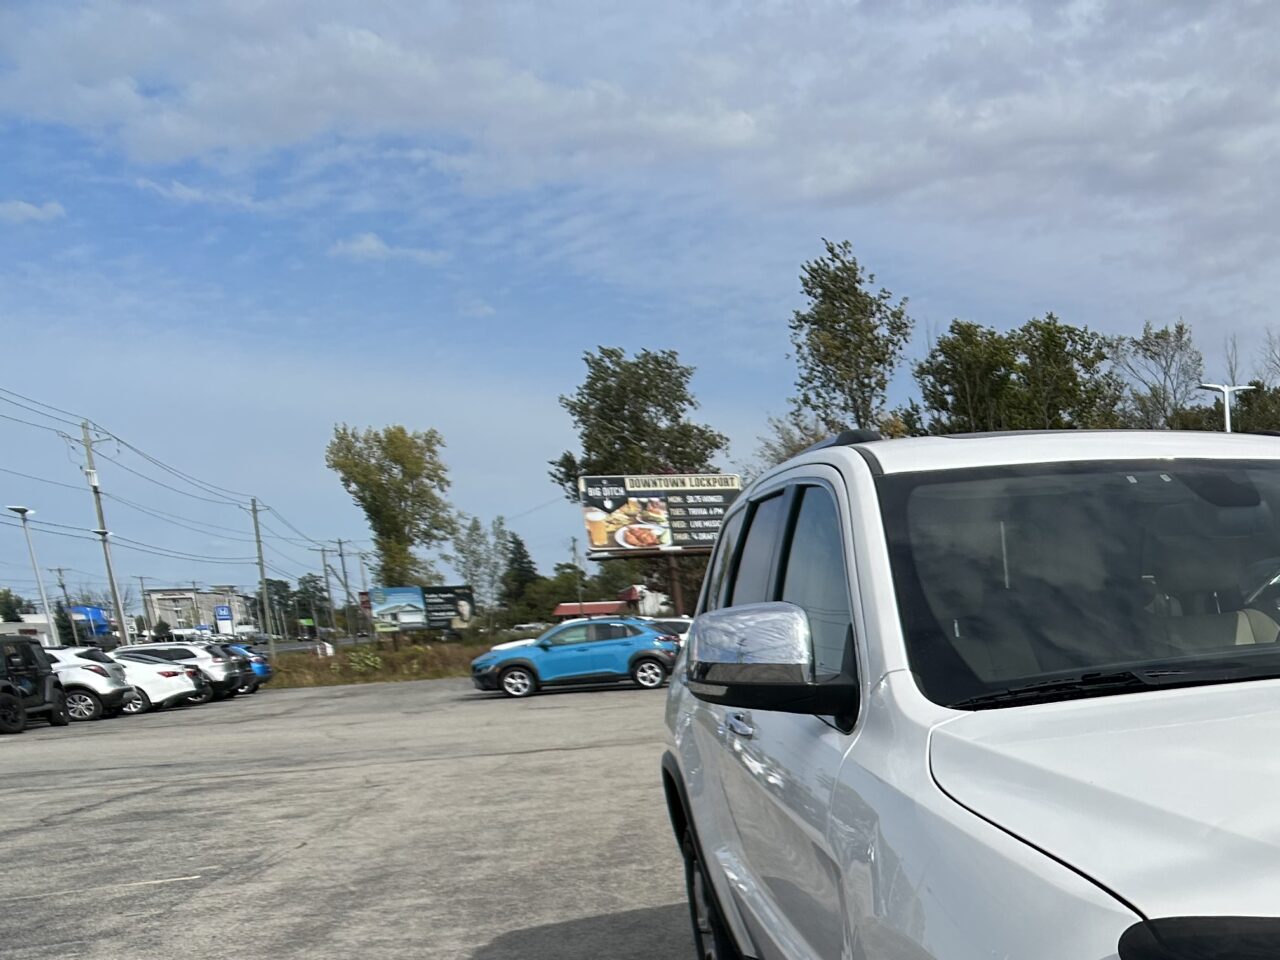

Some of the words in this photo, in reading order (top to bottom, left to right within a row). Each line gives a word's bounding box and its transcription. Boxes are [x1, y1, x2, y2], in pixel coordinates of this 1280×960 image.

[629, 478, 686, 488] DOWNTOWN
[689, 476, 735, 487] LOCKPORT
[587, 487, 601, 496] BIG
[602, 487, 625, 496] DITCH
